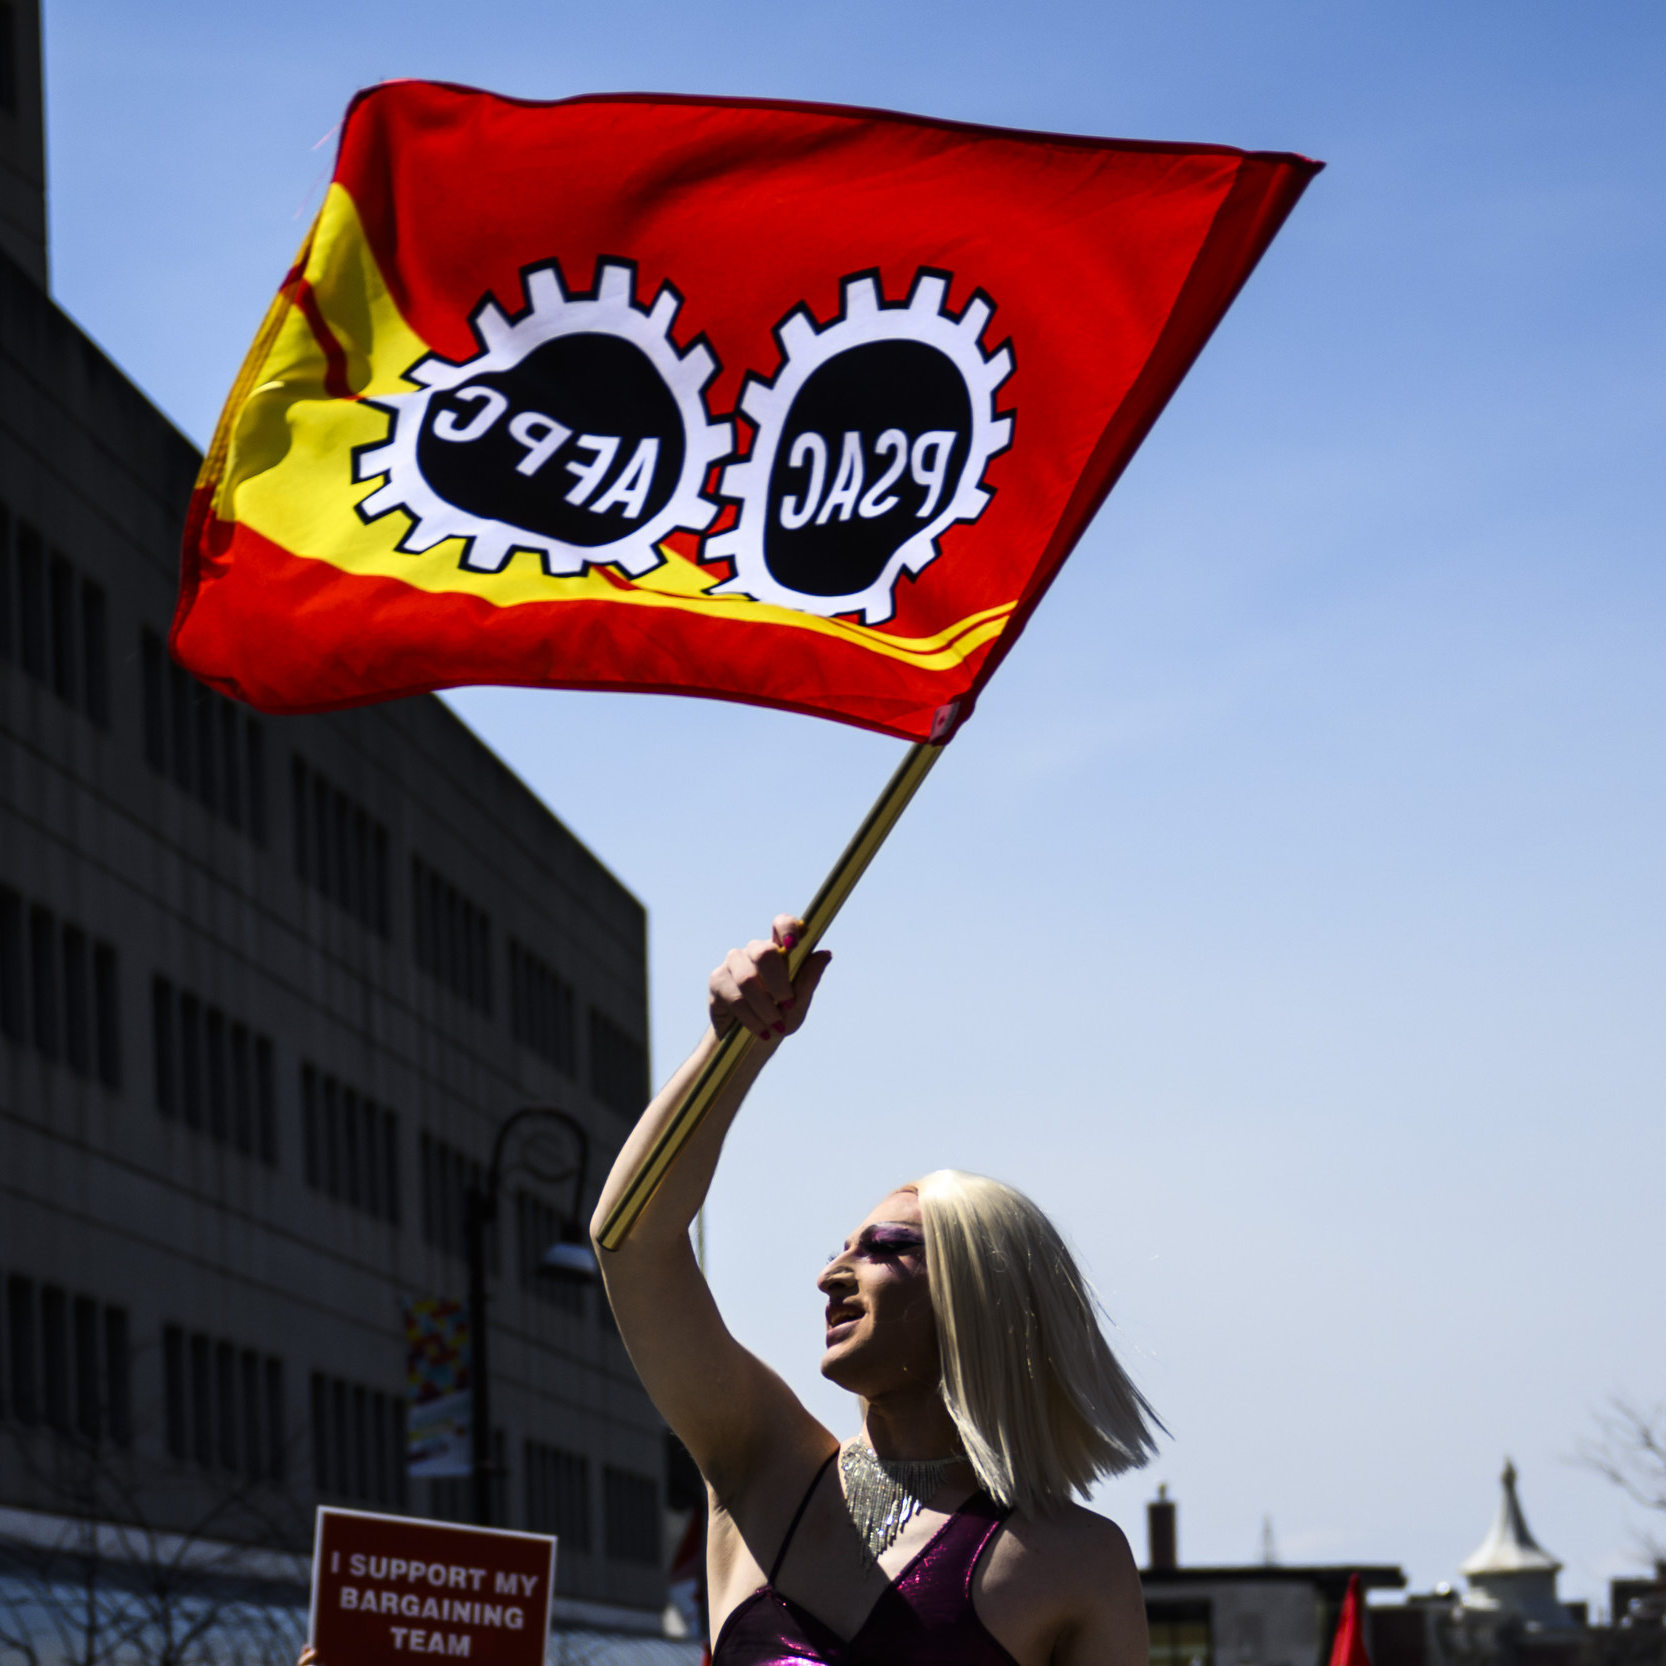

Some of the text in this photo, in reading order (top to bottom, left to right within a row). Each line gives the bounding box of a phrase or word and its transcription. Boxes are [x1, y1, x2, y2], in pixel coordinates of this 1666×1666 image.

[330, 1550, 539, 1598] I SUPPORT MY
[339, 1585, 525, 1630] BARGAINING
[389, 1626, 472, 1658] TEAM
